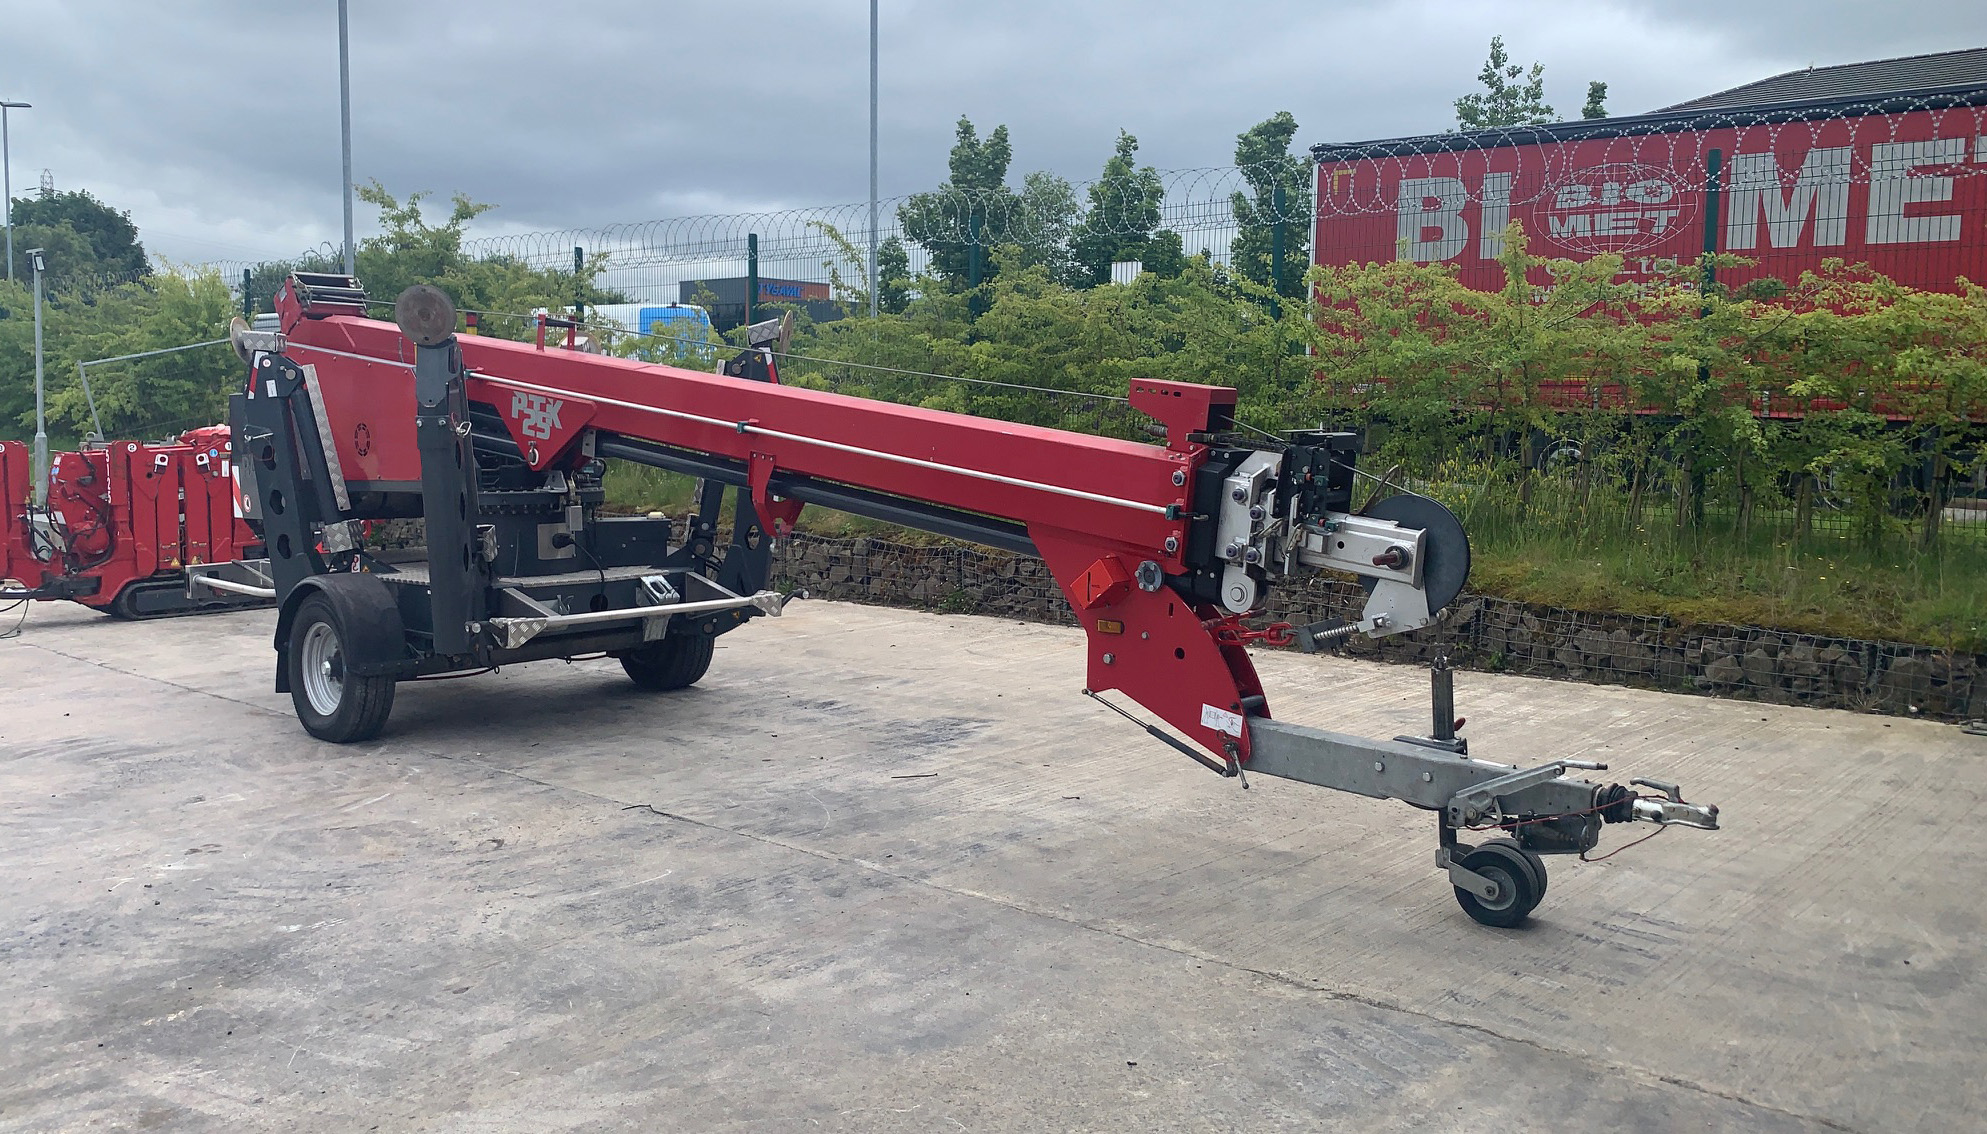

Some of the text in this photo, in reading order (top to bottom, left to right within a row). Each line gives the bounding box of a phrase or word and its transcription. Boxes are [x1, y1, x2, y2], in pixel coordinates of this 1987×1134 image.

[1726, 135, 1987, 250] ME
[1549, 209, 1680, 238] MET
[511, 391, 563, 430] PTK
